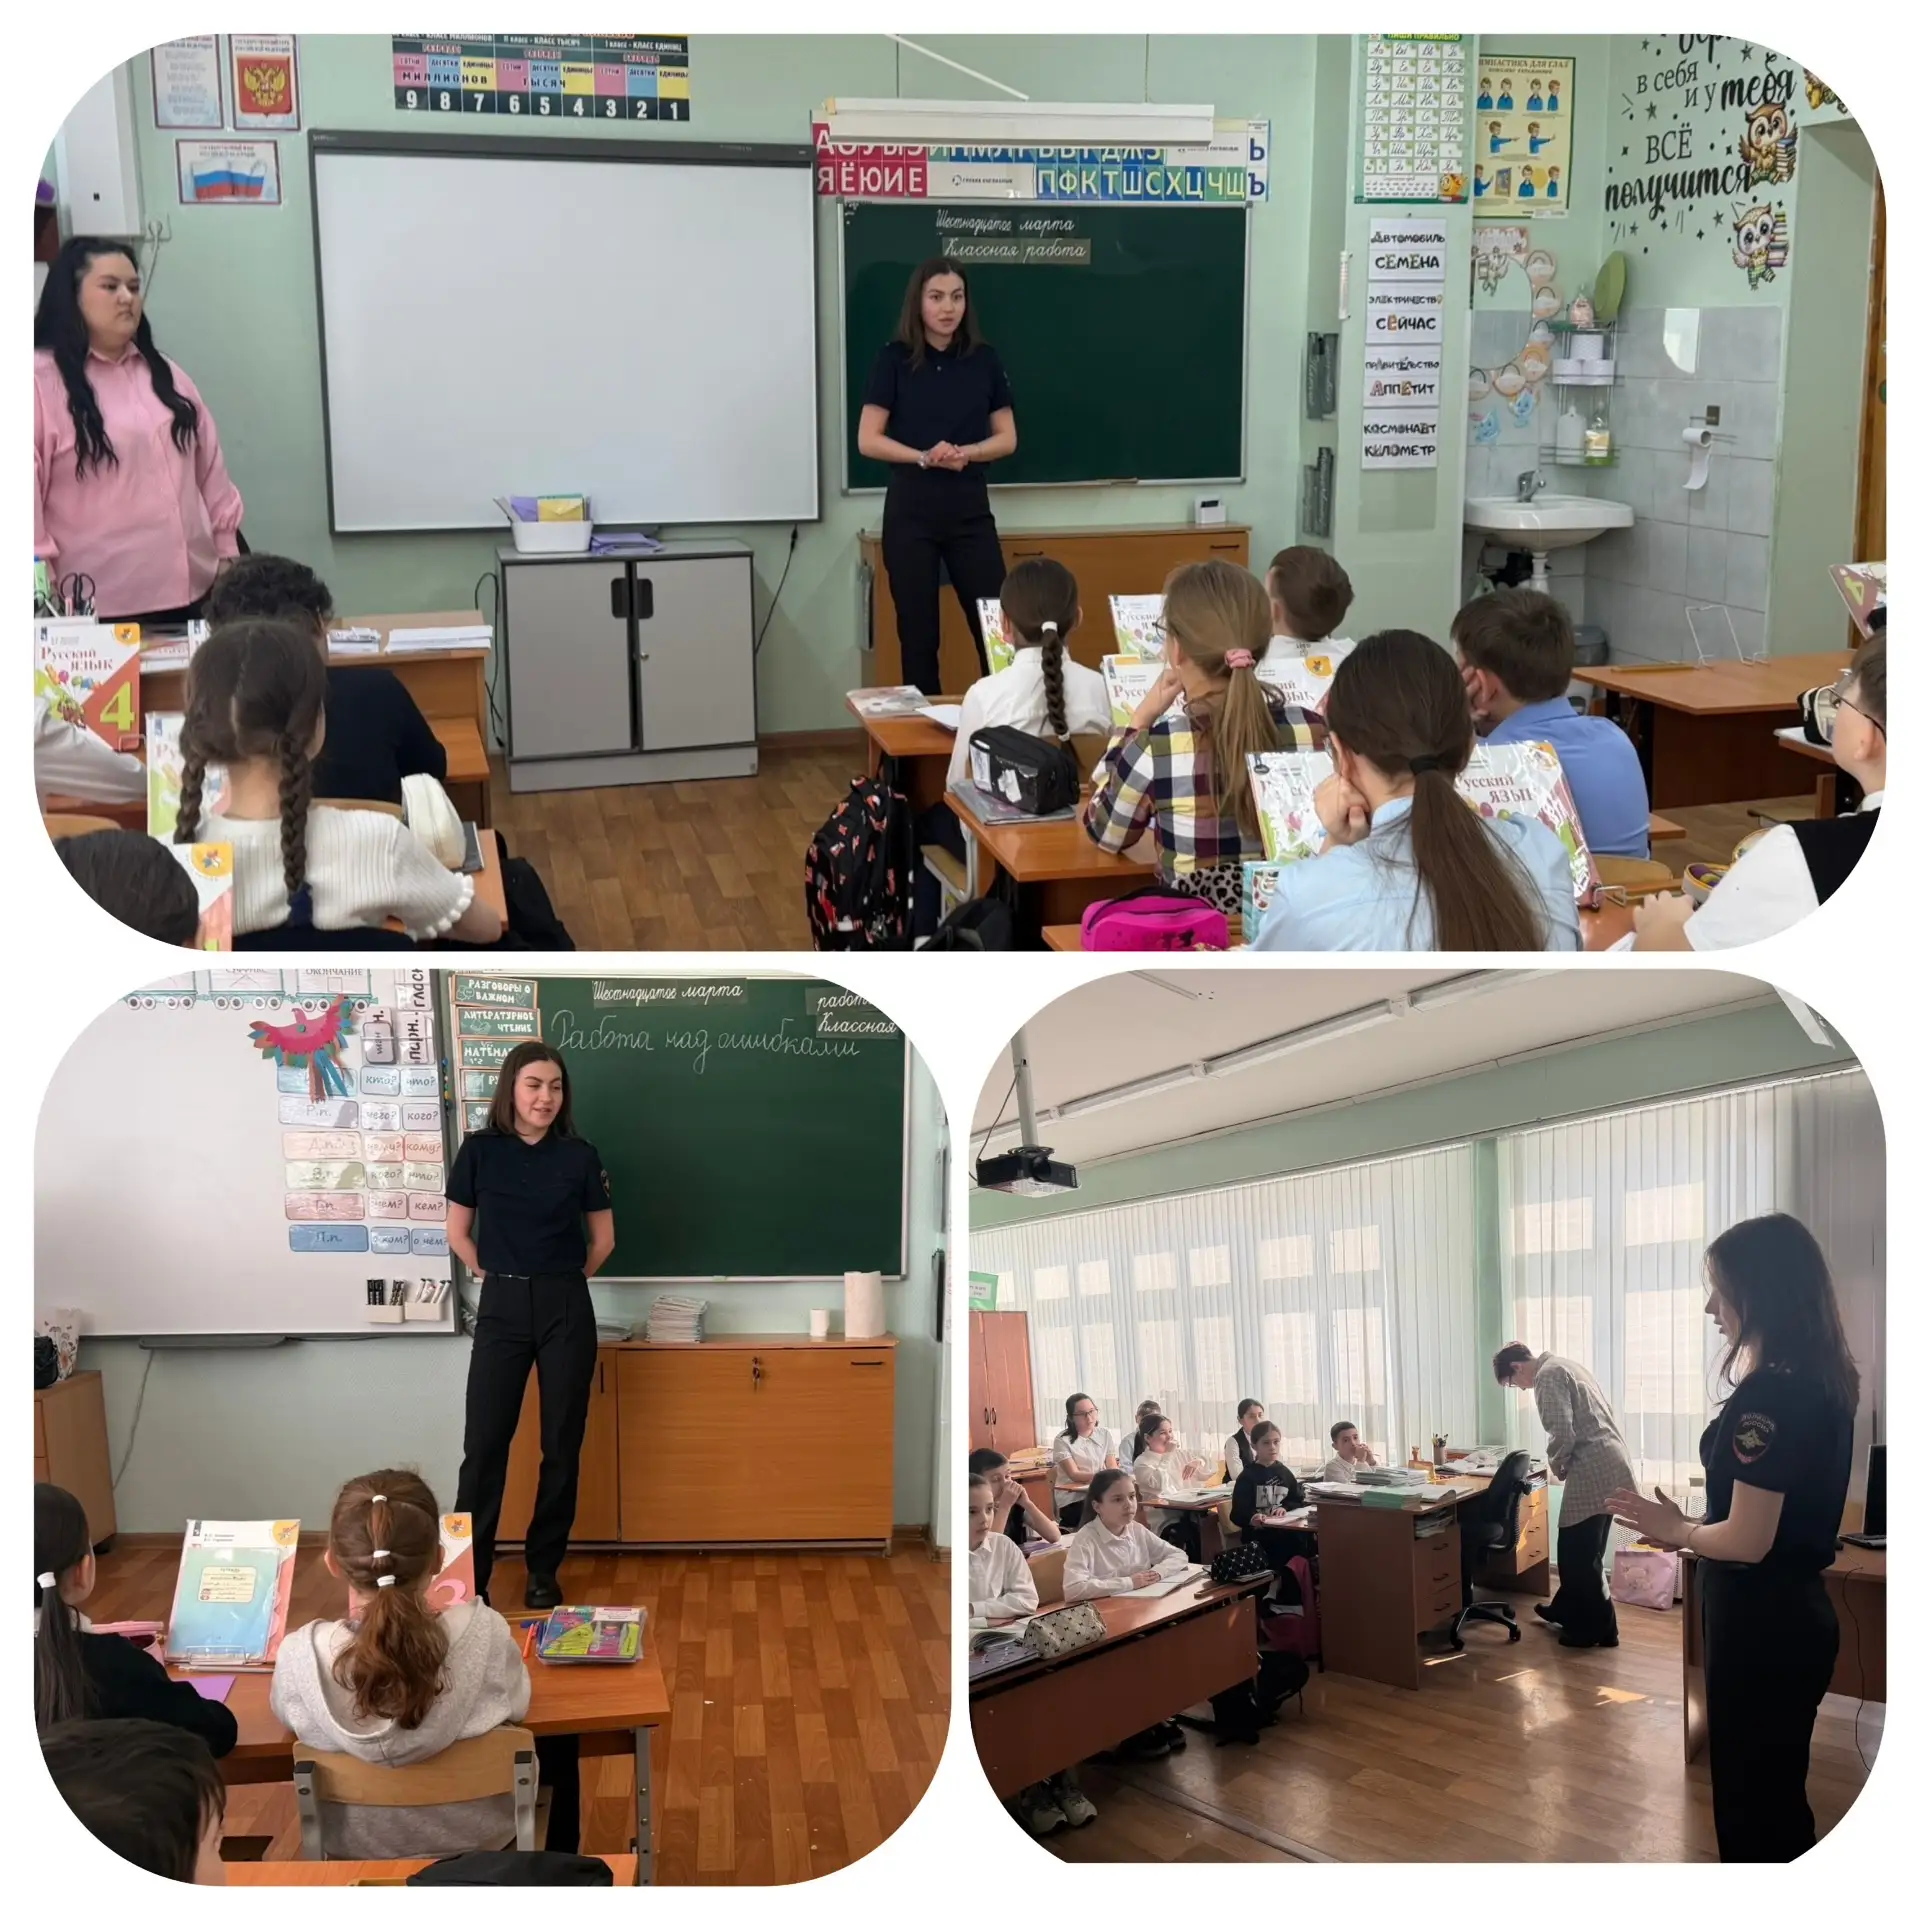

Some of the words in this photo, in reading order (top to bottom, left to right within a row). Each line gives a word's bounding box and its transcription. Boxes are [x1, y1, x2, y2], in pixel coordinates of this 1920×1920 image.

[534, 36, 556, 45] КЛАСС
[633, 41, 654, 50] КЛАСС
[1637, 74, 1648, 95] в
[1654, 59, 1699, 92] себя
[1684, 87, 1699, 108] и
[1704, 82, 1717, 112] у
[1721, 53, 1798, 111] тебя
[405, 90, 418, 109] 9
[439, 91, 452, 110] 8
[473, 93, 485, 111] 7
[508, 95, 521, 114] 6
[539, 96, 551, 115] 5
[572, 98, 585, 116] 4
[605, 99, 617, 118] 3
[636, 101, 648, 119] 2
[669, 102, 679, 120] 1
[1645, 123, 1693, 164] ВСЁ
[1605, 163, 1753, 220] получится
[1019, 219, 1075, 238] марта
[943, 238, 1019, 257] Классная
[1022, 238, 1087, 264] работа
[1375, 253, 1440, 269] СЕМЕНА
[1376, 313, 1436, 331] СЕЙЧАС
[1364, 443, 1436, 457] КИЛОМЕТР
[41, 647, 96, 661] Русский
[100, 681, 135, 731] 4
[468, 980, 523, 993] РАЗГОВОРЫ
[524, 984, 531, 993] О
[591, 980, 678, 1007] Шестнадцатое
[681, 984, 744, 1006] марта
[475, 992, 515, 1003] ВАЖНОМ
[464, 1010, 534, 1021] ЛИТЕРАТУРНОЕ
[817, 1012, 897, 1033] Классная
[497, 1023, 533, 1033] ЧТЕНИЕ
[551, 1009, 655, 1051] Работа
[665, 1028, 712, 1075] над
[718, 1018, 861, 1058] ошибками
[407, 1111, 438, 1122] кого?
[414, 1201, 444, 1211] кем?
